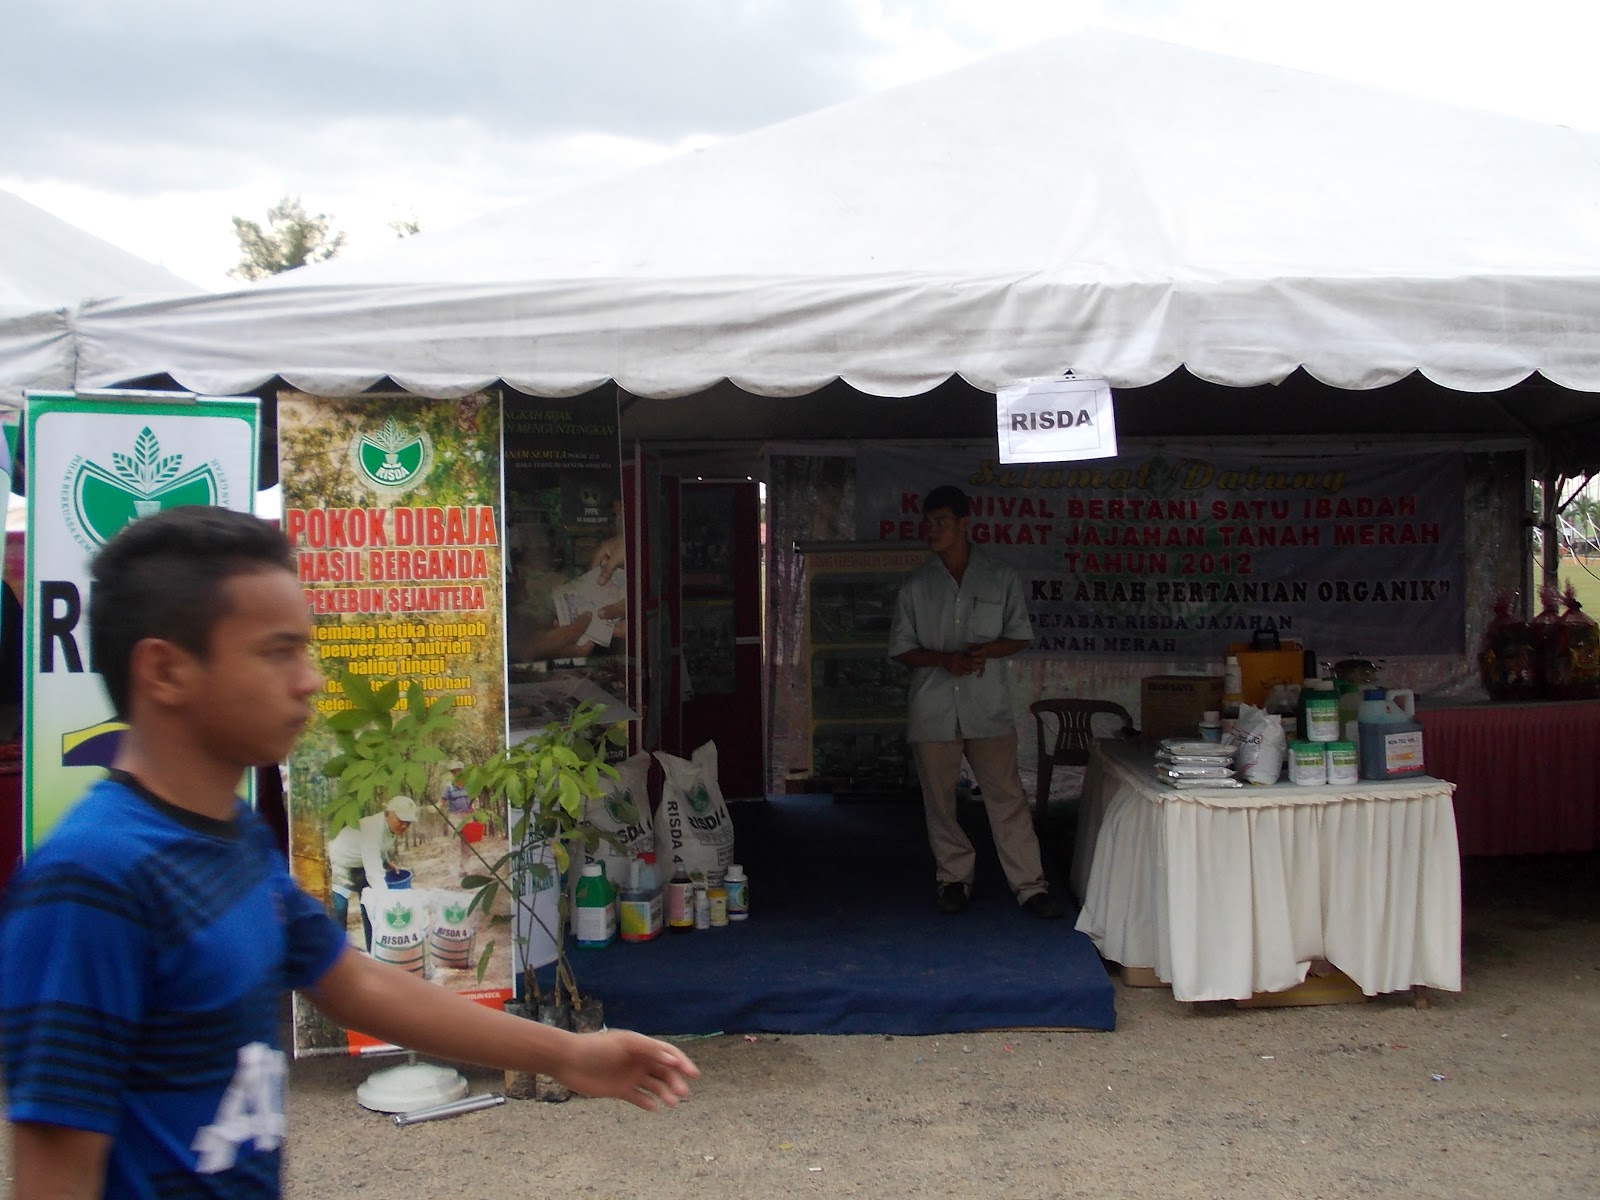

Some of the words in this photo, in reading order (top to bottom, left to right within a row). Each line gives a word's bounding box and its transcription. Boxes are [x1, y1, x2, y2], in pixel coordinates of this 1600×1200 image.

[517, 422, 614, 436] MENGUNTUNGKAN
[1011, 409, 1094, 431] RISDA
[531, 449, 569, 460] SEMULA
[375, 466, 411, 481] RISDA
[969, 459, 1151, 491] Selamat
[1169, 458, 1345, 494] Datang
[901, 492, 1055, 520] KNIVAL
[1067, 498, 1198, 521] BERTANI
[1211, 500, 1290, 521] SATU
[1303, 496, 1417, 520] IBADAH
[287, 508, 388, 549] POKOK
[393, 506, 498, 547] DIBAJA
[1064, 525, 1205, 547] JAJAHAN
[1218, 525, 1321, 547] TANAH
[1334, 522, 1441, 546] MERAH
[299, 551, 365, 583] HASIL
[369, 549, 488, 581] BERGANDA
[1064, 552, 1168, 575] TAHUN
[1181, 552, 1253, 575] 2012
[303, 586, 385, 615] PEKEBUN
[387, 585, 485, 613] SEJAHTERA
[1031, 580, 1064, 602] KE
[1075, 580, 1147, 603] ARAH
[1156, 580, 1309, 603] PERTANIAN
[378, 622, 426, 639] ketika
[428, 620, 487, 638] tempoh
[1029, 614, 1118, 630] PEJABAT
[1125, 614, 1189, 630] RISDA
[1195, 614, 1293, 631] JAJAHAN
[320, 642, 413, 659] penyerapan
[415, 639, 472, 655] nutrien
[1031, 635, 1094, 651] ANAH
[1104, 636, 1177, 652] MERAH
[399, 656, 446, 675] tinggi
[421, 676, 443, 691] 100
[445, 675, 472, 690] hari
[667, 801, 684, 850] RISDA
[672, 855, 684, 864] 4
[380, 934, 411, 946] RISDA
[412, 932, 419, 942] 4
[437, 926, 460, 938] RISDA
[461, 929, 468, 937] 4
